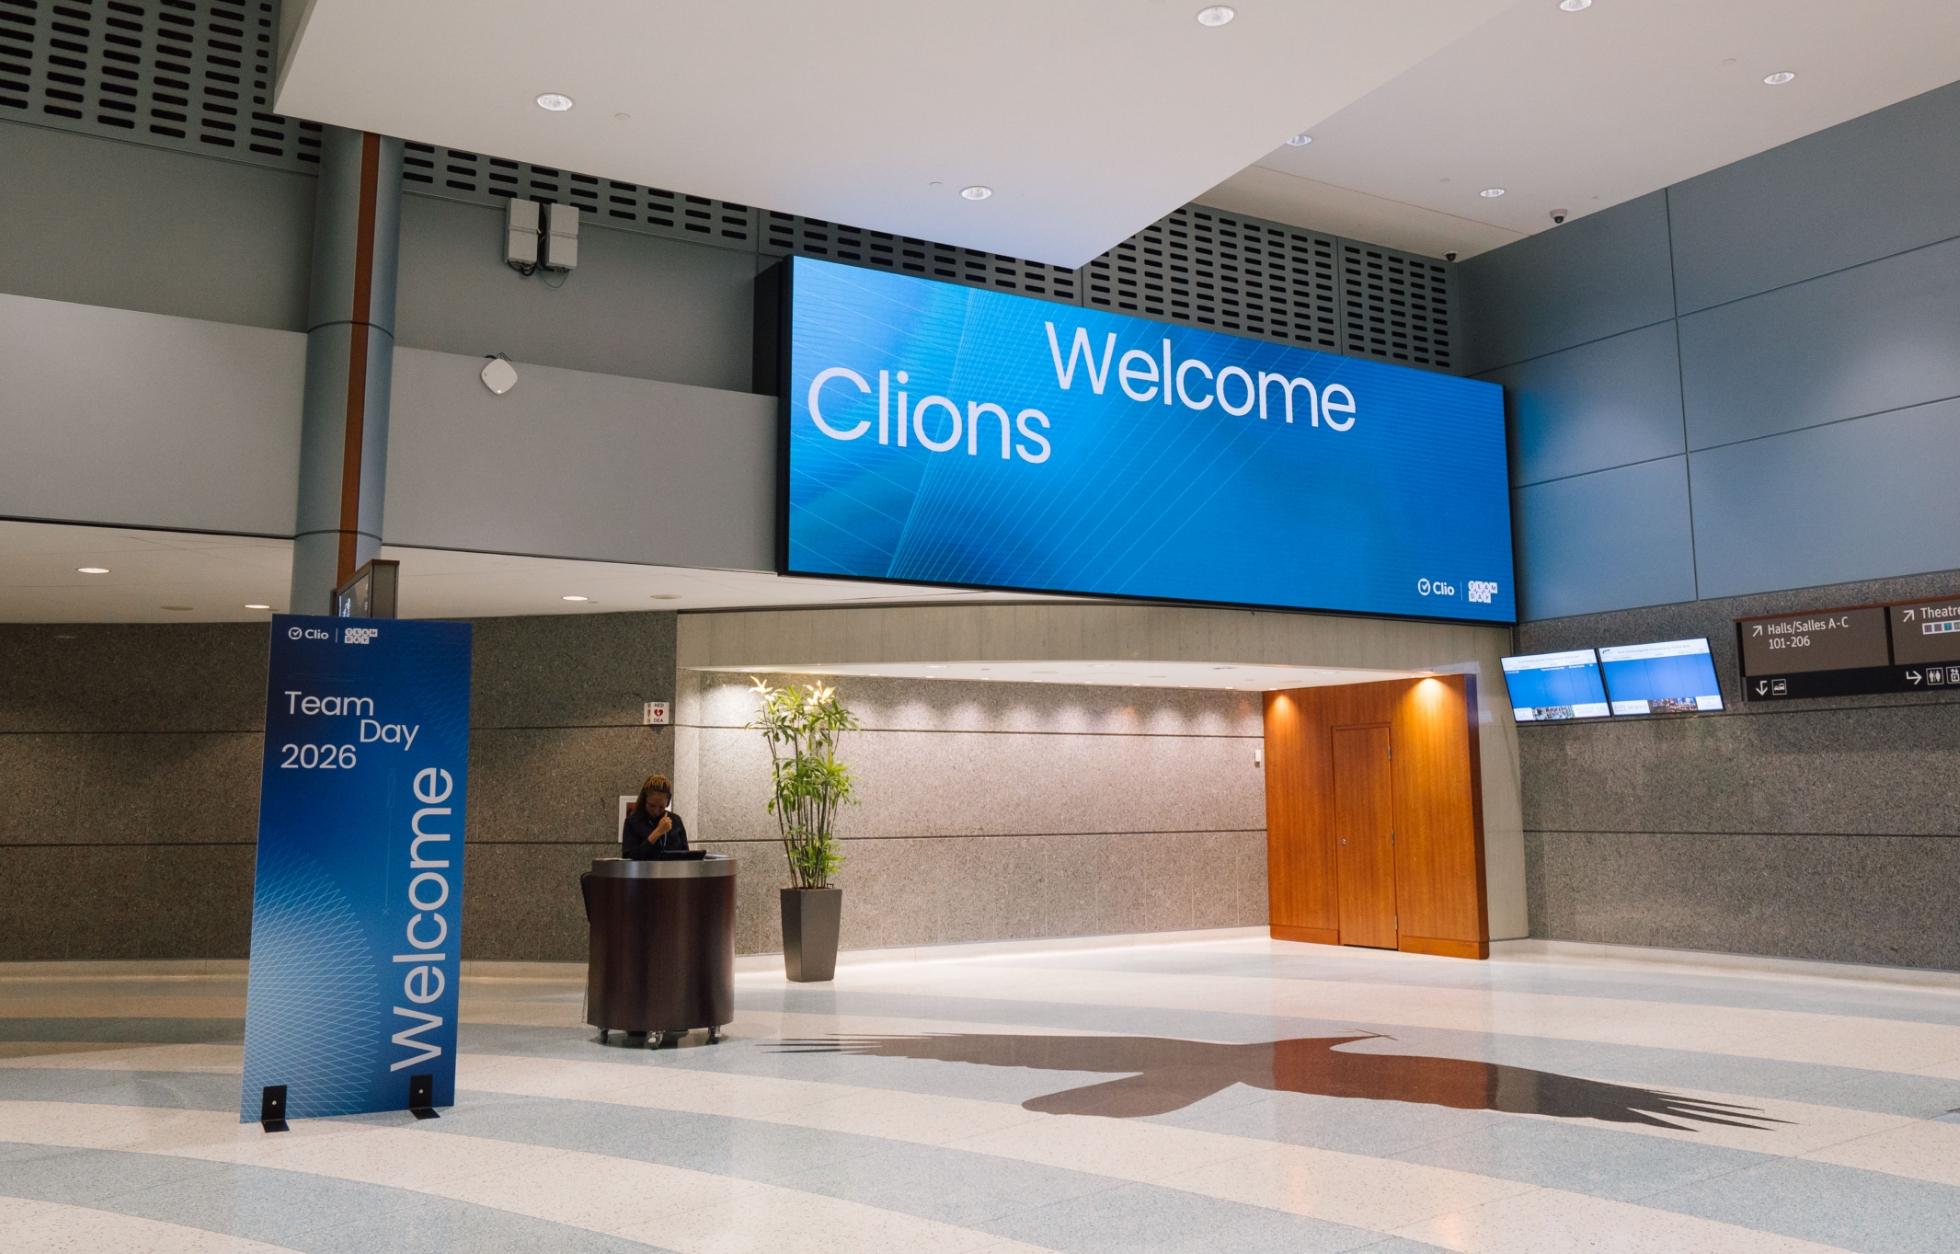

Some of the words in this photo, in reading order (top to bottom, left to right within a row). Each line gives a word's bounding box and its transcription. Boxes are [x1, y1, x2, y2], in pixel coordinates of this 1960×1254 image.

[1044, 320, 1357, 432] Welcome
[807, 366, 1051, 464] Clions
[1433, 581, 1455, 595] Clio
[304, 629, 329, 640] Clio
[1767, 618, 1826, 635] Halls/Salles
[1828, 616, 1849, 629] A-C
[1768, 635, 1811, 649] 101-206
[284, 690, 375, 716] Team
[359, 719, 420, 751] Day
[280, 743, 357, 769] 2026
[390, 766, 454, 1073] Welcome
